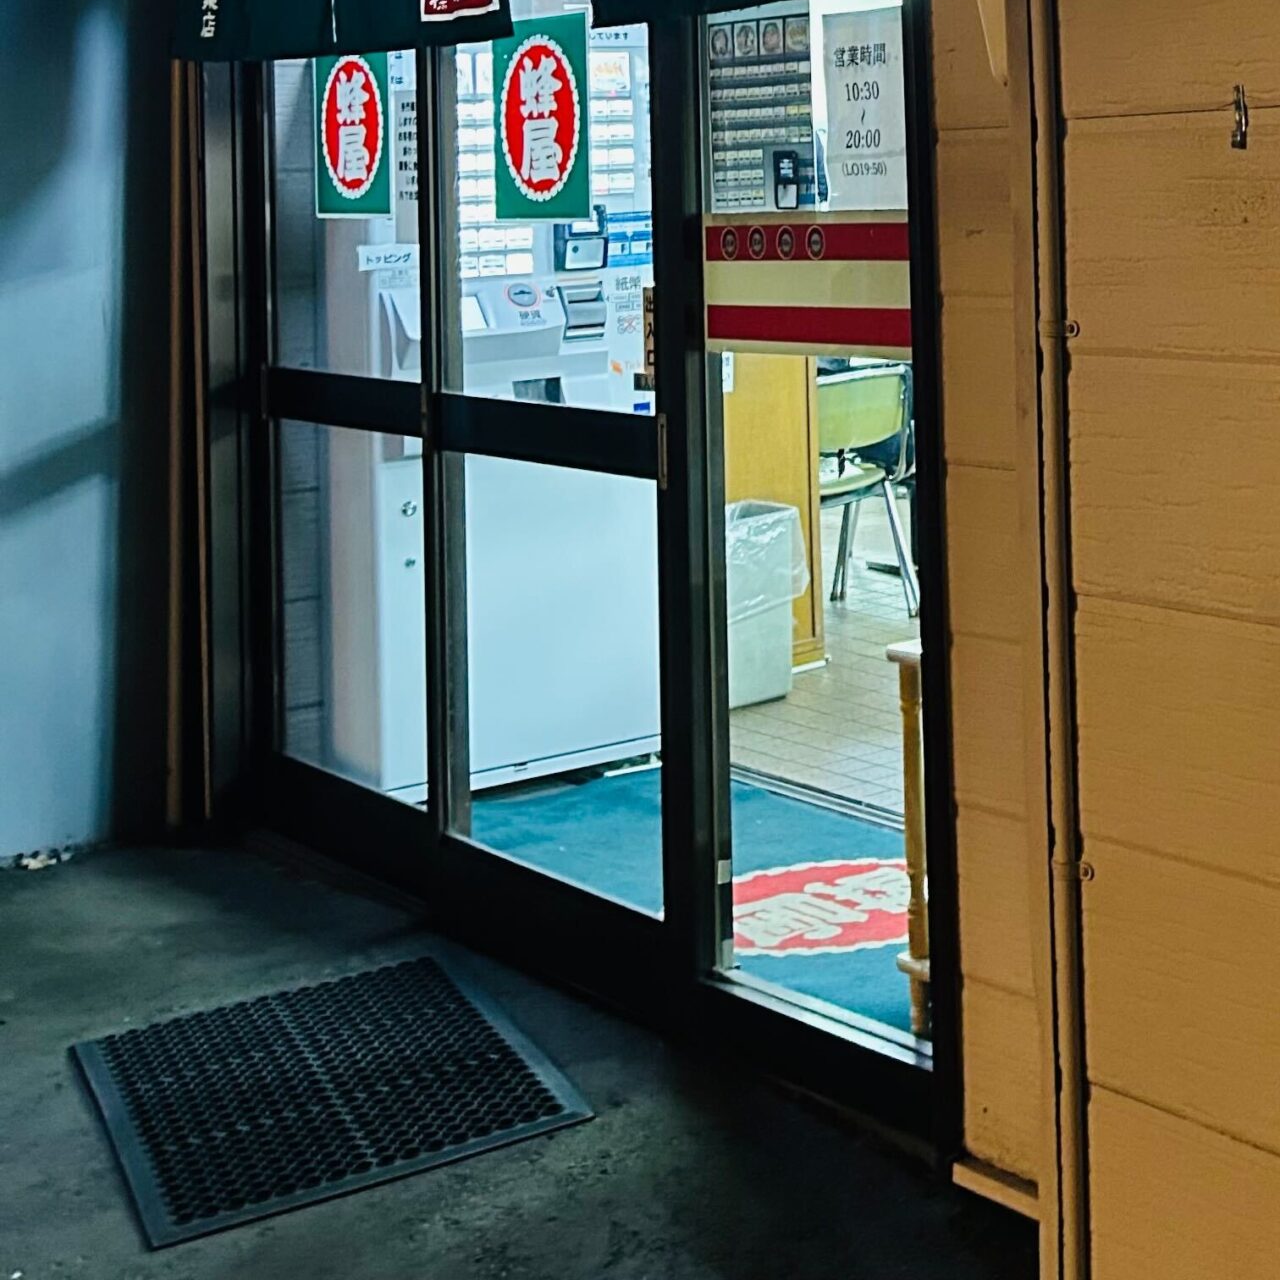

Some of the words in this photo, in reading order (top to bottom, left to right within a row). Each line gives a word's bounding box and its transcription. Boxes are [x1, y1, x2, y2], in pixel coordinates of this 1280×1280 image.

[833, 43, 886, 68] 営業時間
[845, 81, 880, 101] 10:30
[336, 70, 370, 182] 蜂屋
[519, 54, 563, 184] 蜂屋
[845, 129, 881, 149] 20:00
[366, 252, 412, 265] トッピング
